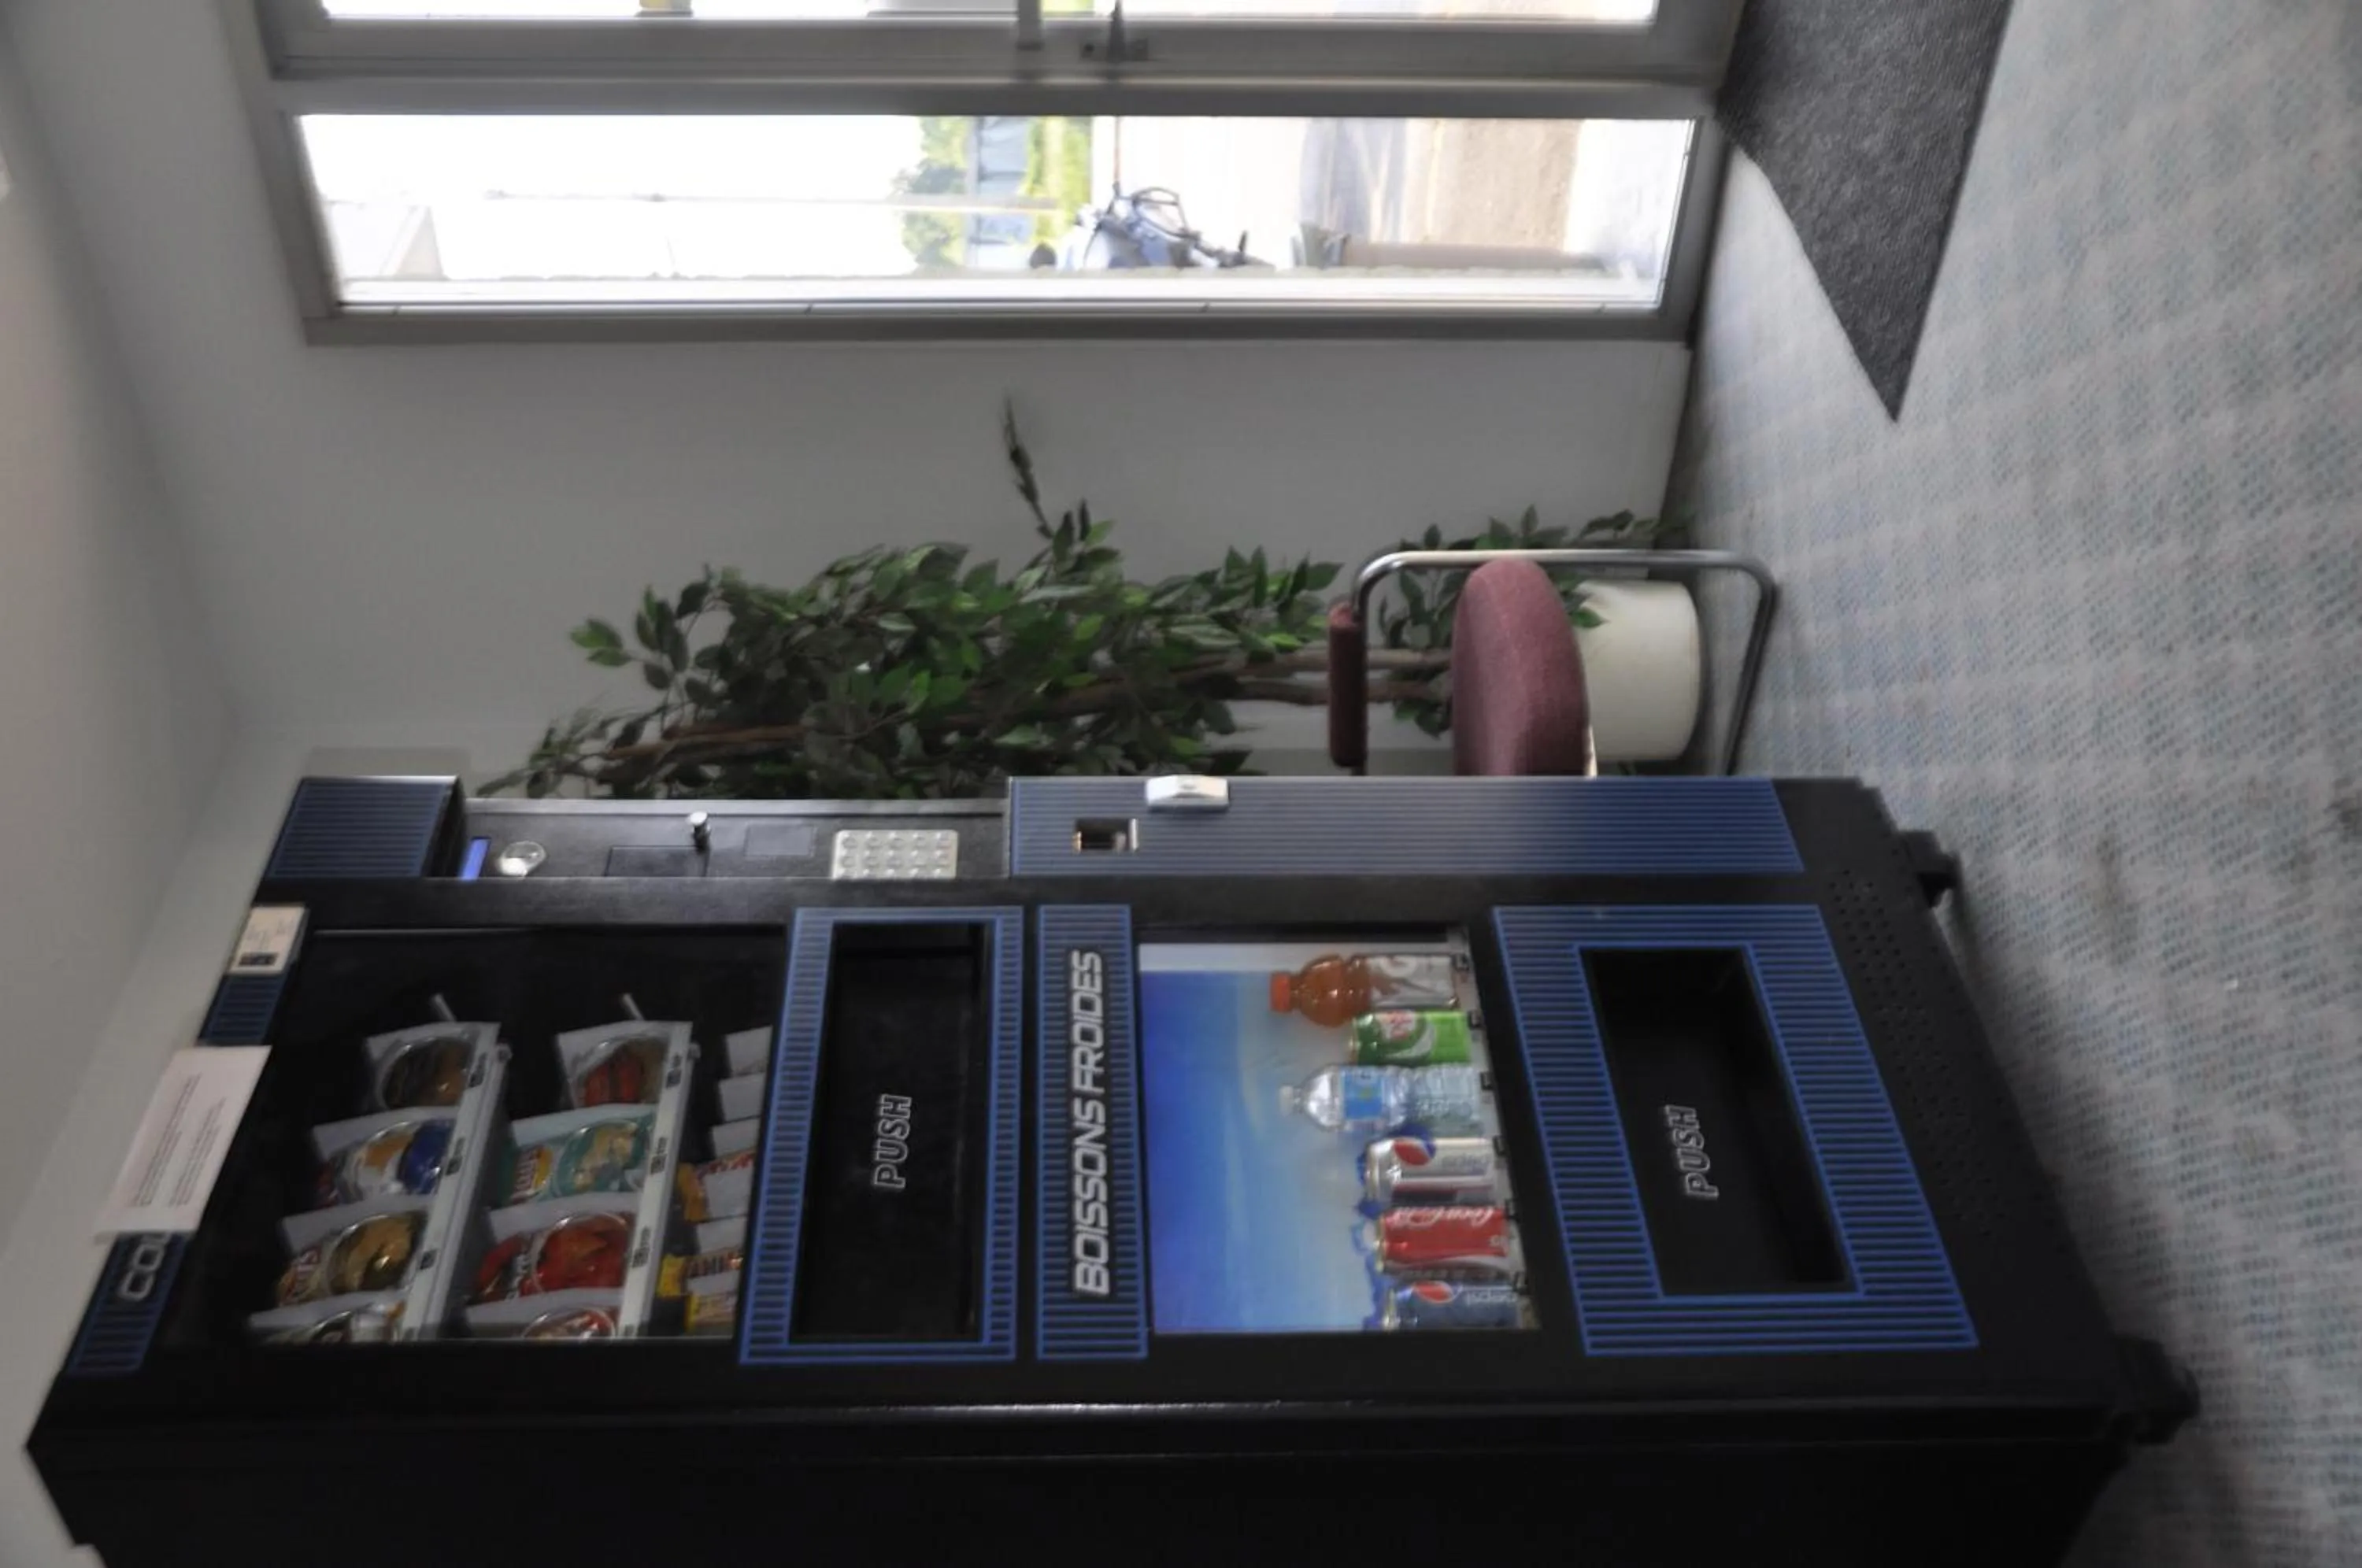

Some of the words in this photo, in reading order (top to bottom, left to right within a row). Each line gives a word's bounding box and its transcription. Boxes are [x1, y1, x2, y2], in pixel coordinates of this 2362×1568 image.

[1071, 949, 1105, 1093] FROIDES
[871, 1094, 913, 1189] PUSH
[1072, 1099, 1110, 1295] BOISSONS
[1664, 1104, 1720, 1200] PUSH
